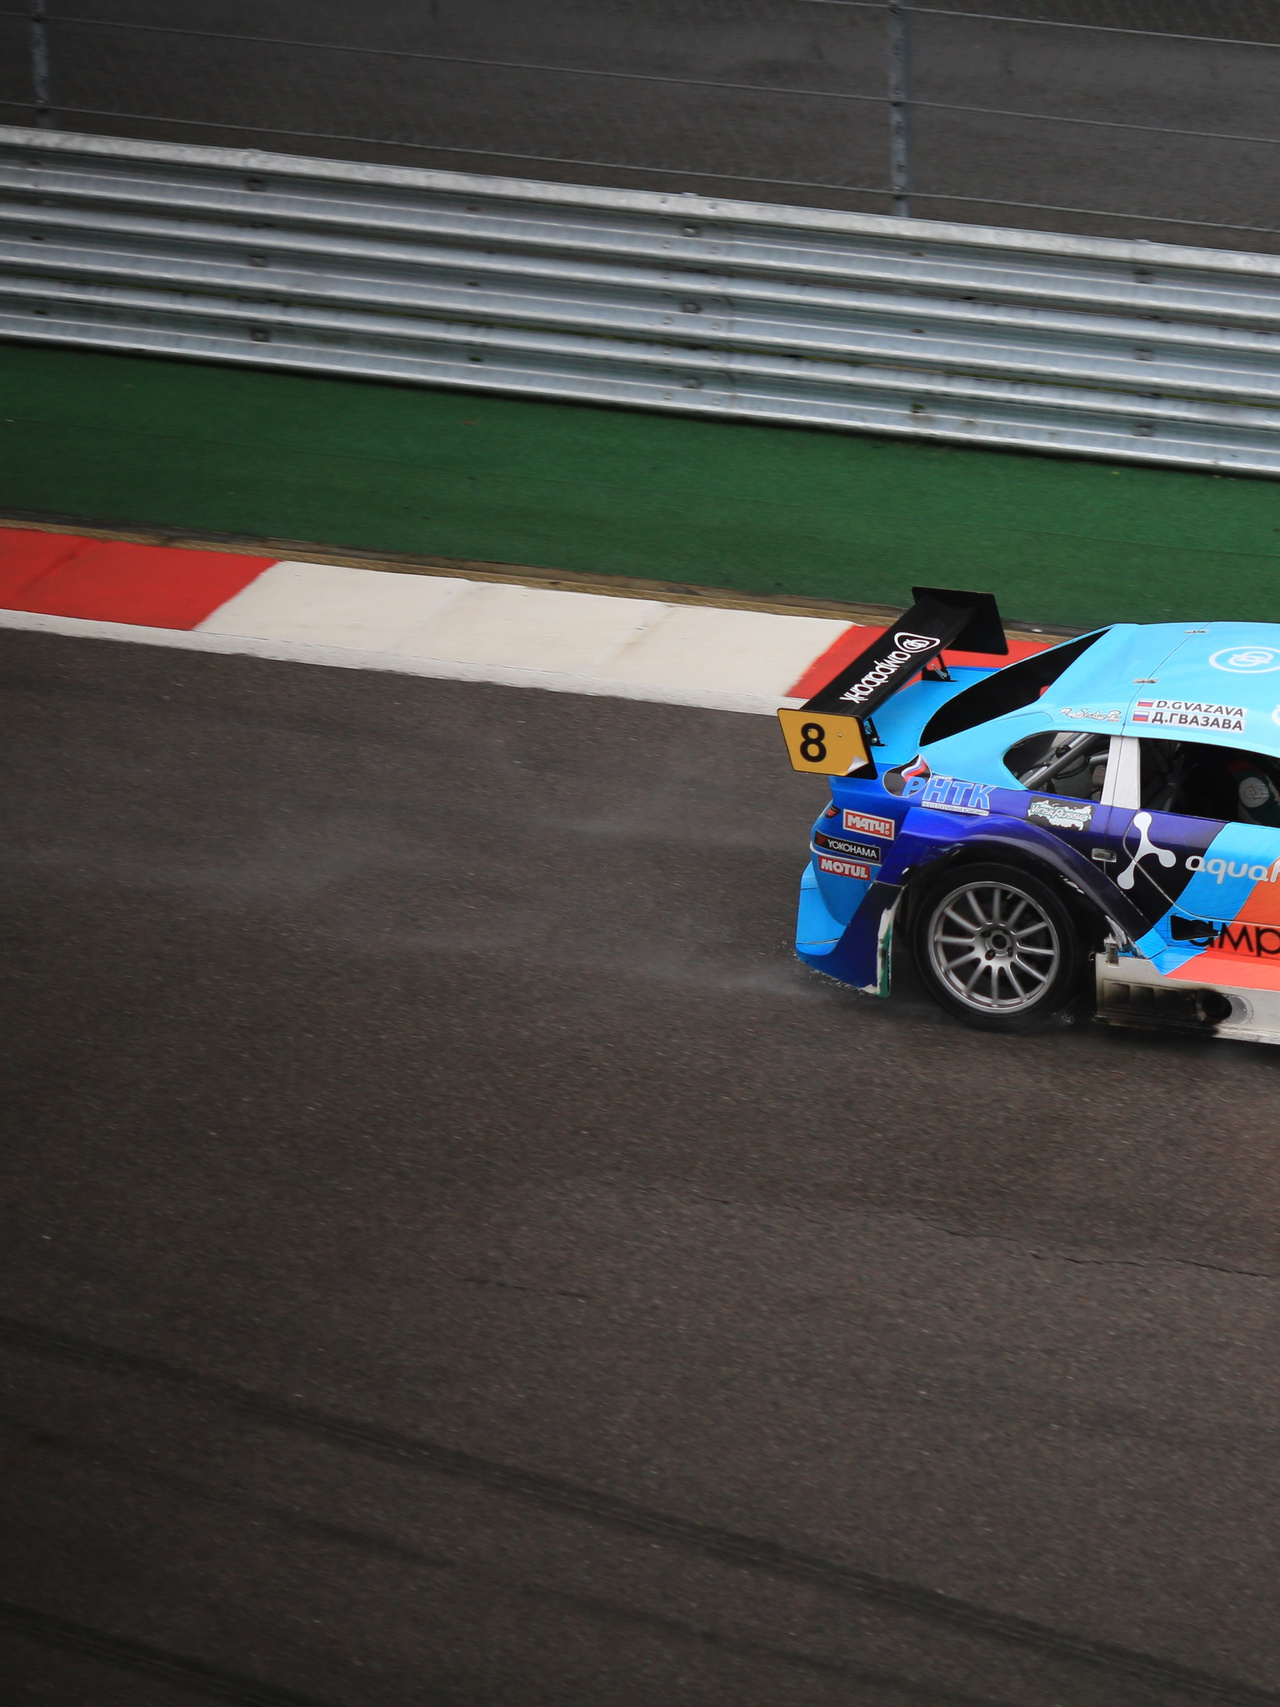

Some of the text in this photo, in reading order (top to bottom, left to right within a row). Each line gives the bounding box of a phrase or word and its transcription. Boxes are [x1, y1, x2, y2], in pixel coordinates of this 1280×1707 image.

[1156, 700, 1244, 718] D.GVAZAVA
[1151, 711, 1244, 731] Д.ГВАЗАВА
[800, 722, 827, 763] 8
[902, 776, 997, 810] РНТК
[847, 814, 890, 835] МАТЧ!
[827, 839, 878, 859] YOKOHAMA
[820, 858, 868, 879] MOTUL
